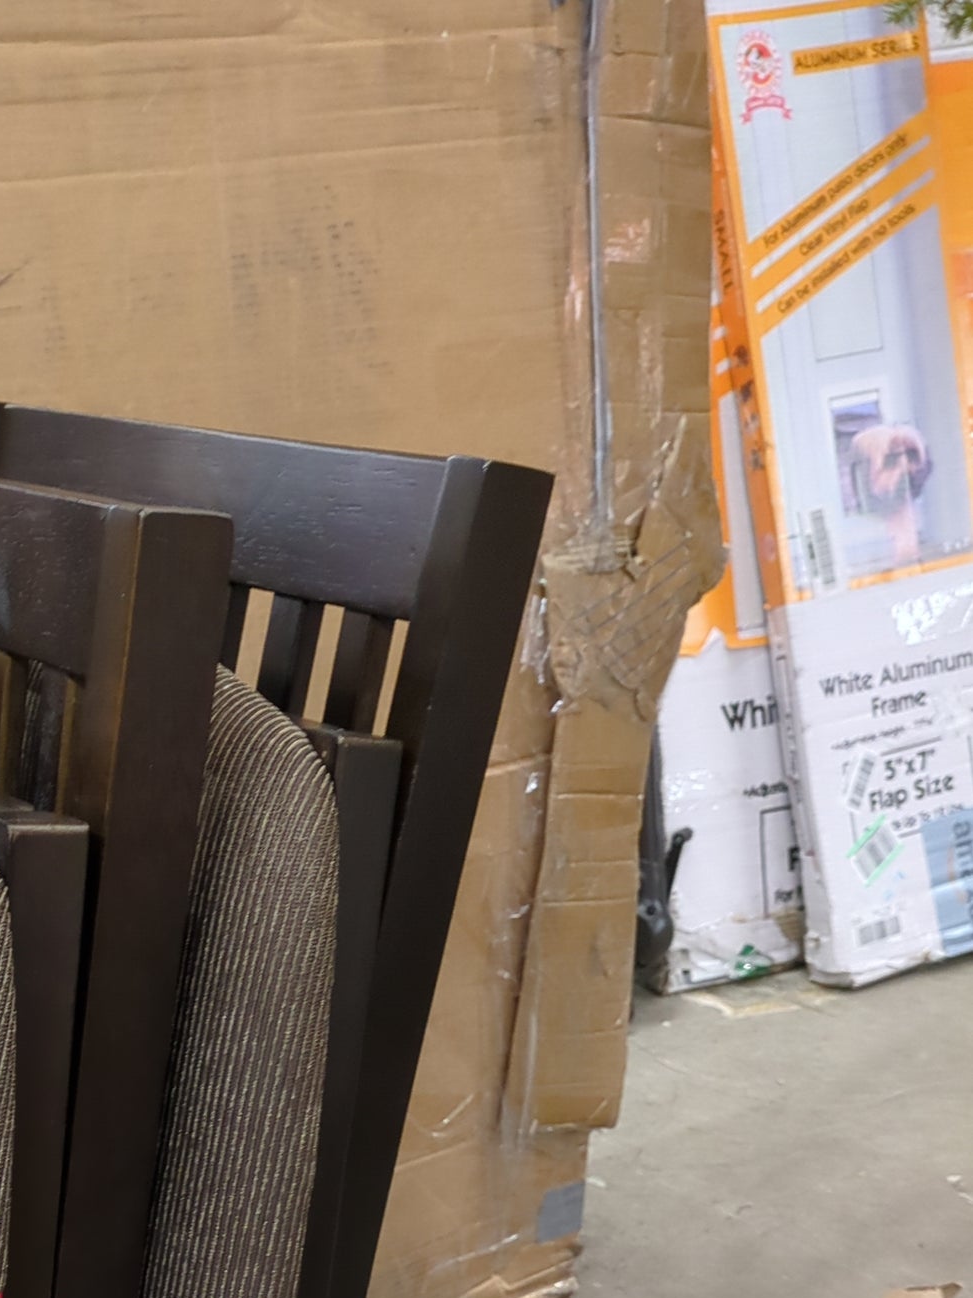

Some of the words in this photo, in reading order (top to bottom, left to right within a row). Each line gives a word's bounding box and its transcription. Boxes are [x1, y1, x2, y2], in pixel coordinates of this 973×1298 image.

[870, 35, 920, 60] SERS
[819, 671, 873, 698] White
[879, 651, 973, 686] Aluminum
[871, 690, 927, 718] Frame
[869, 787, 908, 813] Flap
[913, 775, 954, 800] Size
